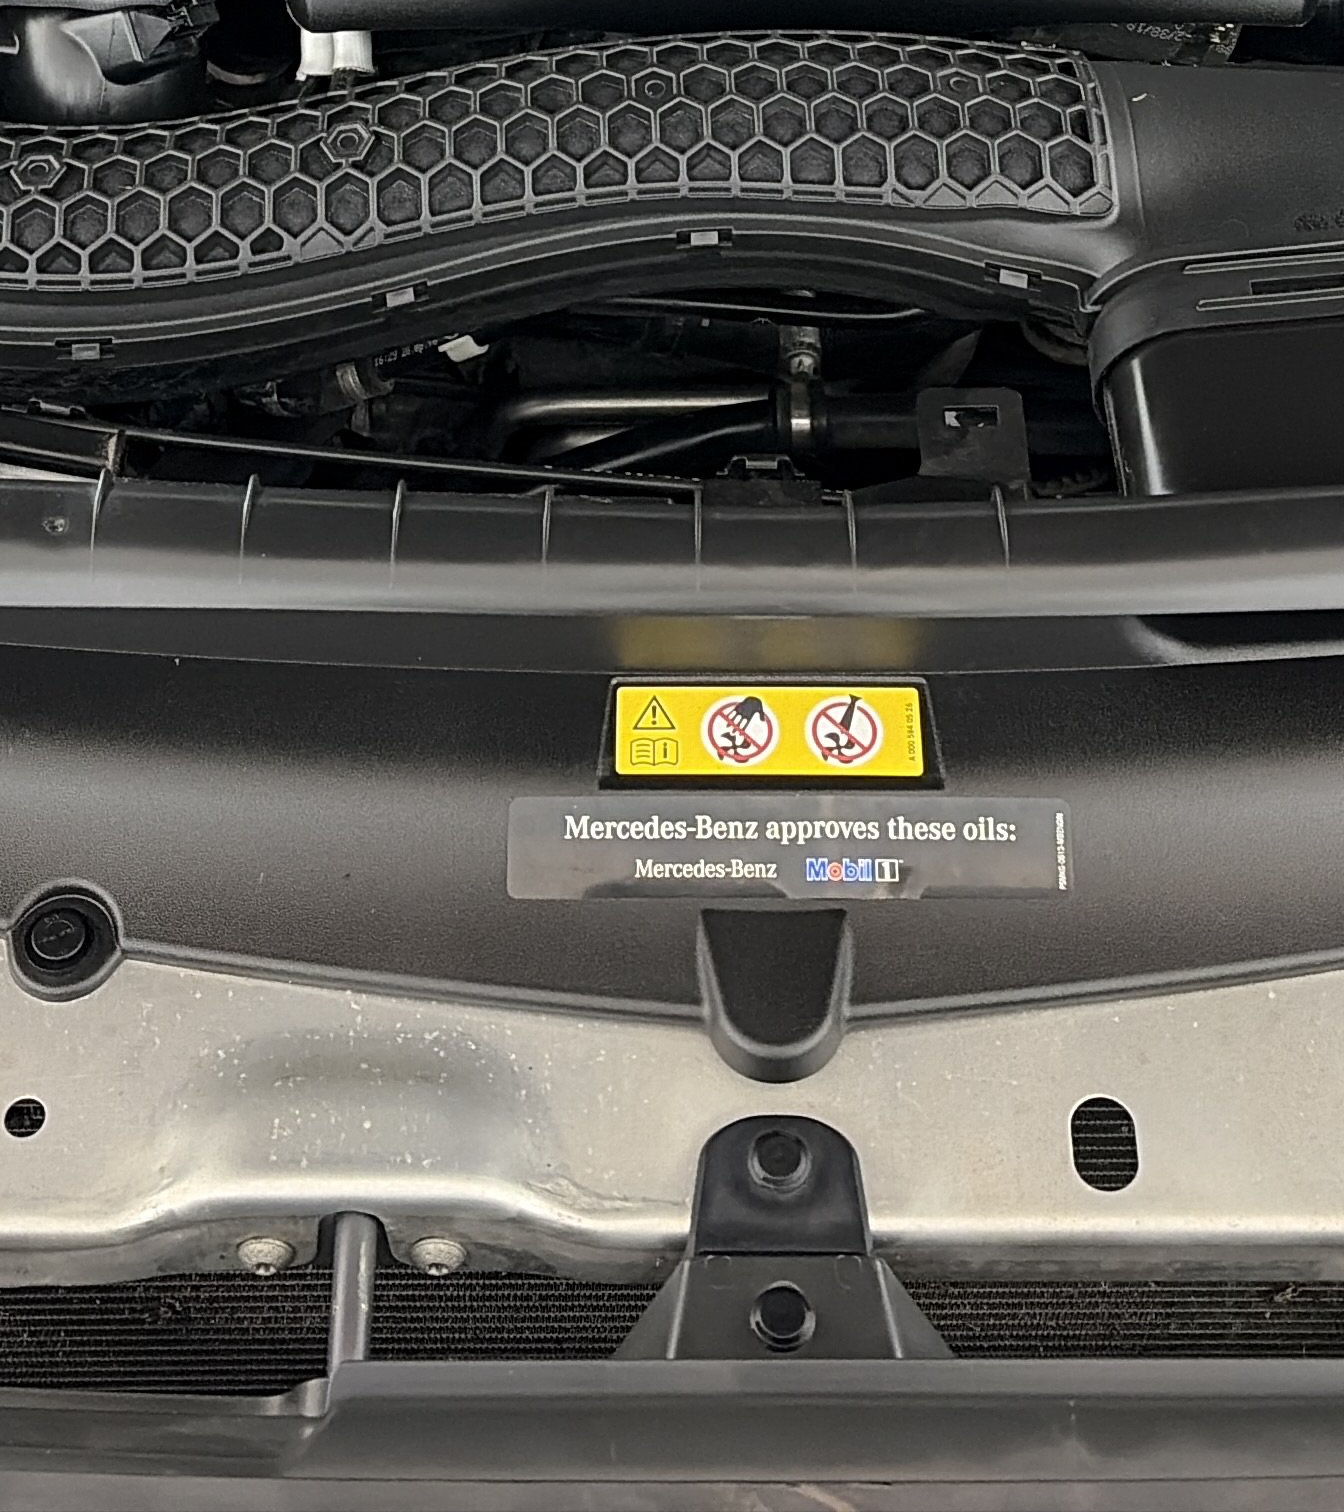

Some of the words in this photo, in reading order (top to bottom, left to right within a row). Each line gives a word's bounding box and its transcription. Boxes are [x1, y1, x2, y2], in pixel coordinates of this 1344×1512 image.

[564, 814, 759, 840] Mercedes-Benz
[765, 819, 880, 845] approves
[887, 815, 955, 840] these
[962, 815, 1017, 840] oils:
[634, 857, 778, 879] Mercedes-Benz
[805, 857, 873, 882] Mobil
